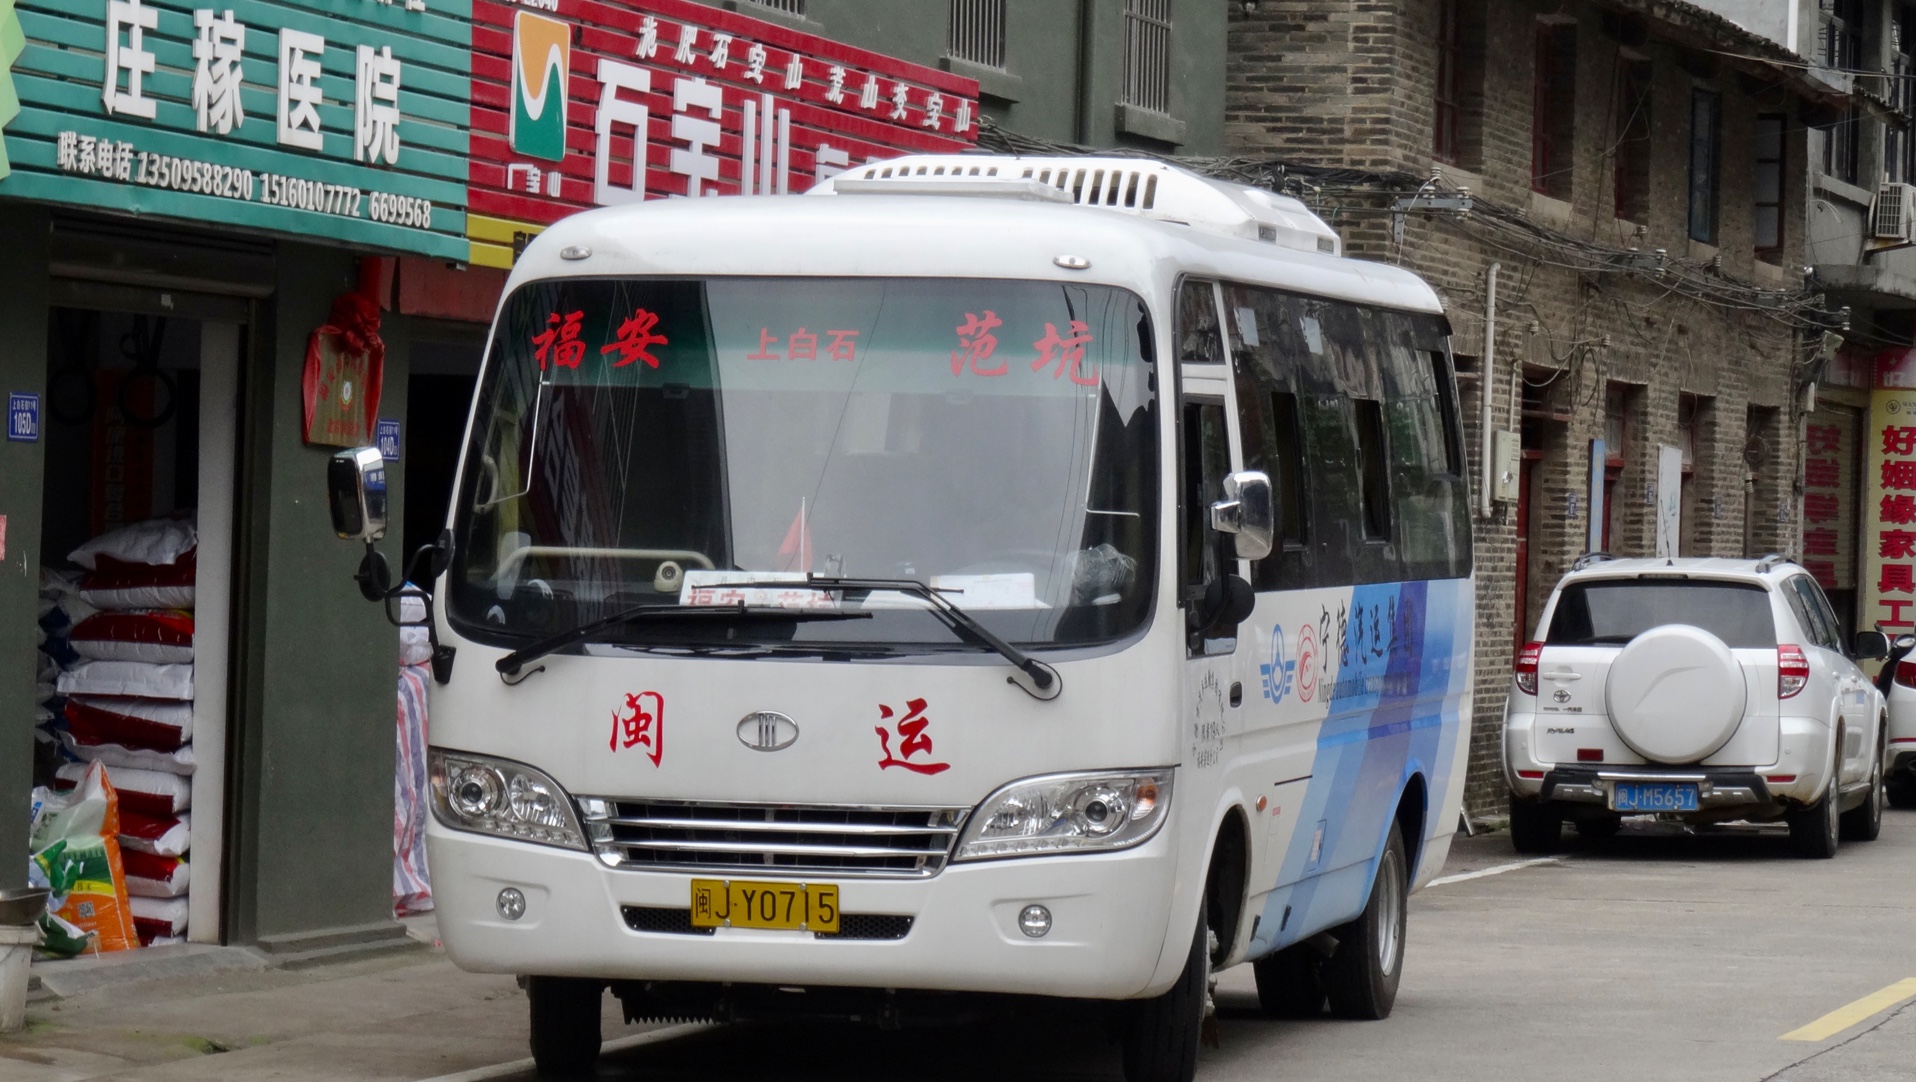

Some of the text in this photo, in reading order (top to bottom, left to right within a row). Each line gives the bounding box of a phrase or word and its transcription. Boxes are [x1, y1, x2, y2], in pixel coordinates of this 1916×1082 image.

[103, 0, 401, 164] 庄稼医院
[594, 59, 870, 207] 石宝山
[57, 131, 432, 228] 联系电话 13509588290 15160107772 6699568
[531, 308, 1100, 386] 福安 上白石 范坑
[1872, 425, 1916, 682] 好姻缘家具工
[609, 691, 951, 775] 闽 运
